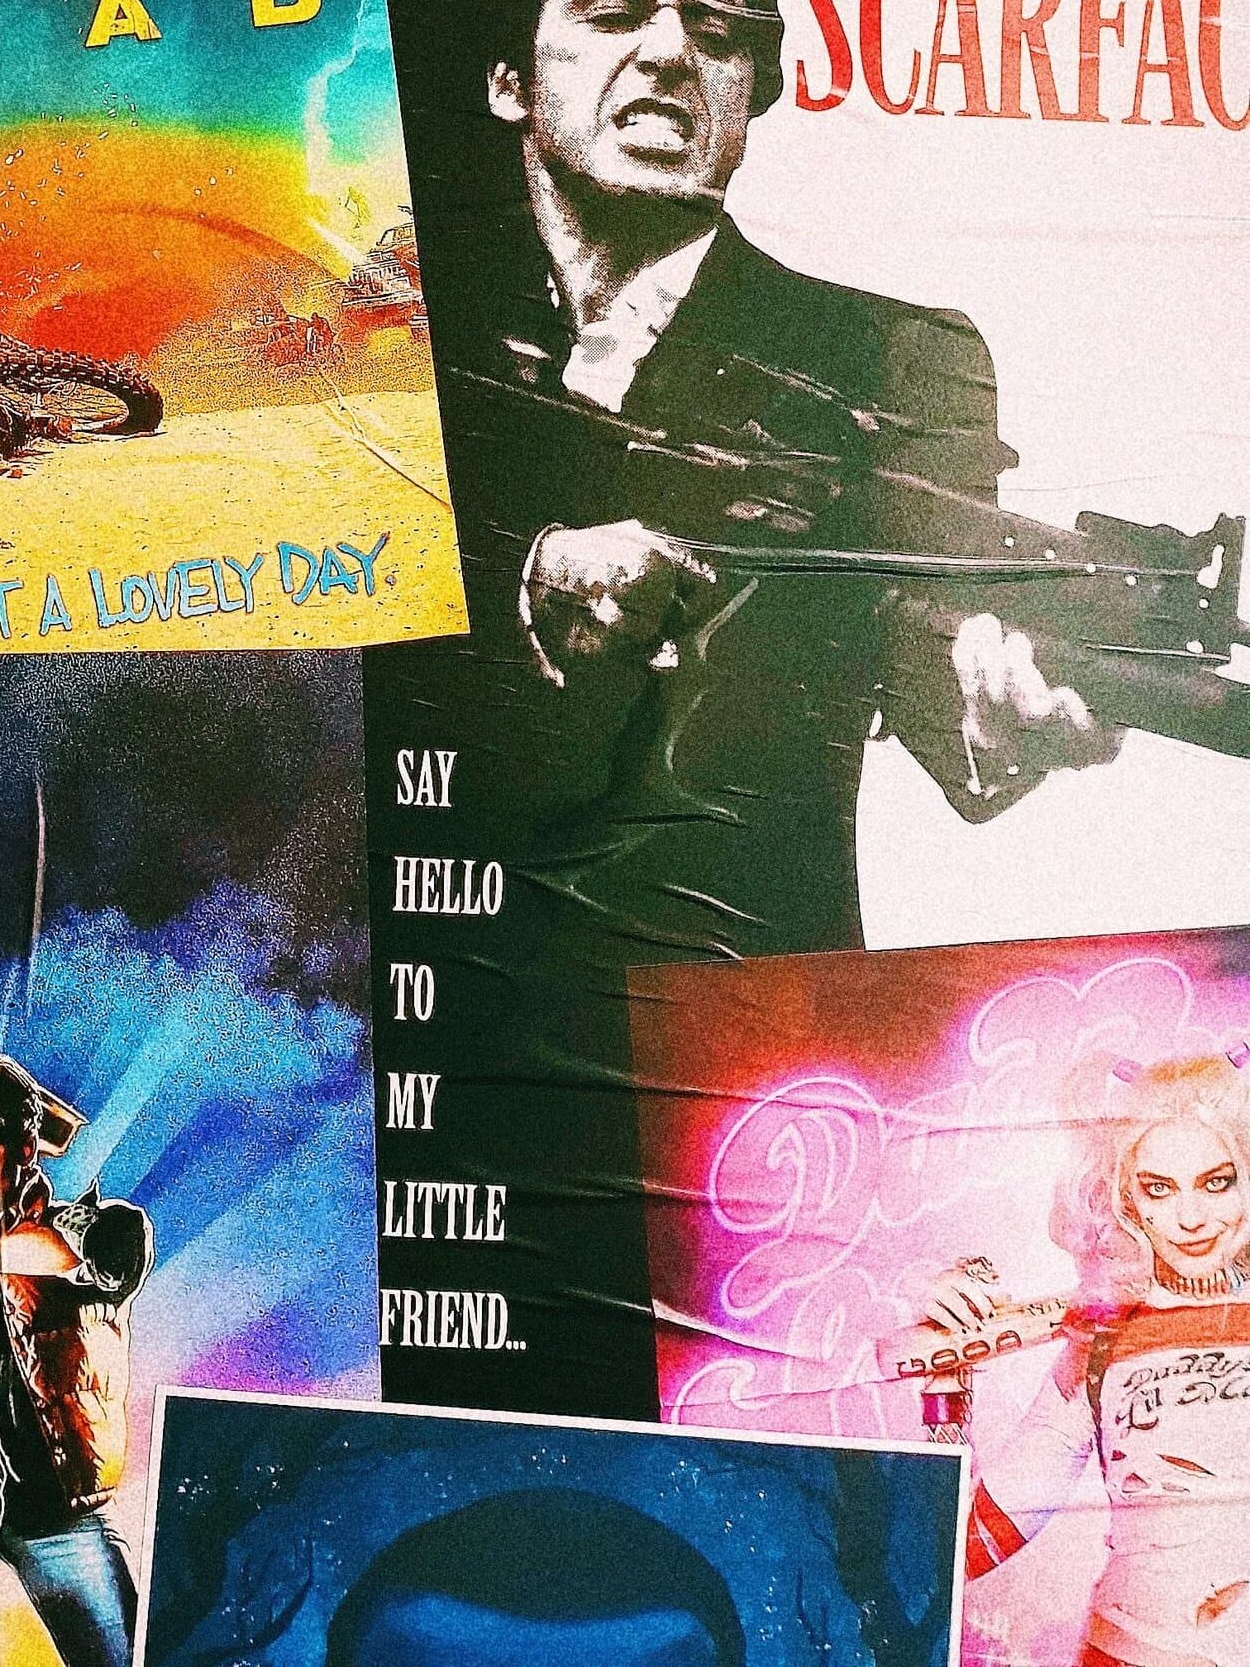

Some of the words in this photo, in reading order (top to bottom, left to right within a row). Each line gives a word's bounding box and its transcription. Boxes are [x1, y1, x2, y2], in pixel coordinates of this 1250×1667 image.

[38, 573, 73, 635] A
[87, 552, 264, 628] LOVELY
[276, 532, 397, 605] DAY.
[396, 749, 458, 808] SAY
[392, 855, 504, 916] HELLO
[390, 963, 436, 1022] TO
[385, 1071, 442, 1131] MY
[382, 1179, 508, 1243] LITTLE
[378, 1288, 527, 1351] FRIEND...
